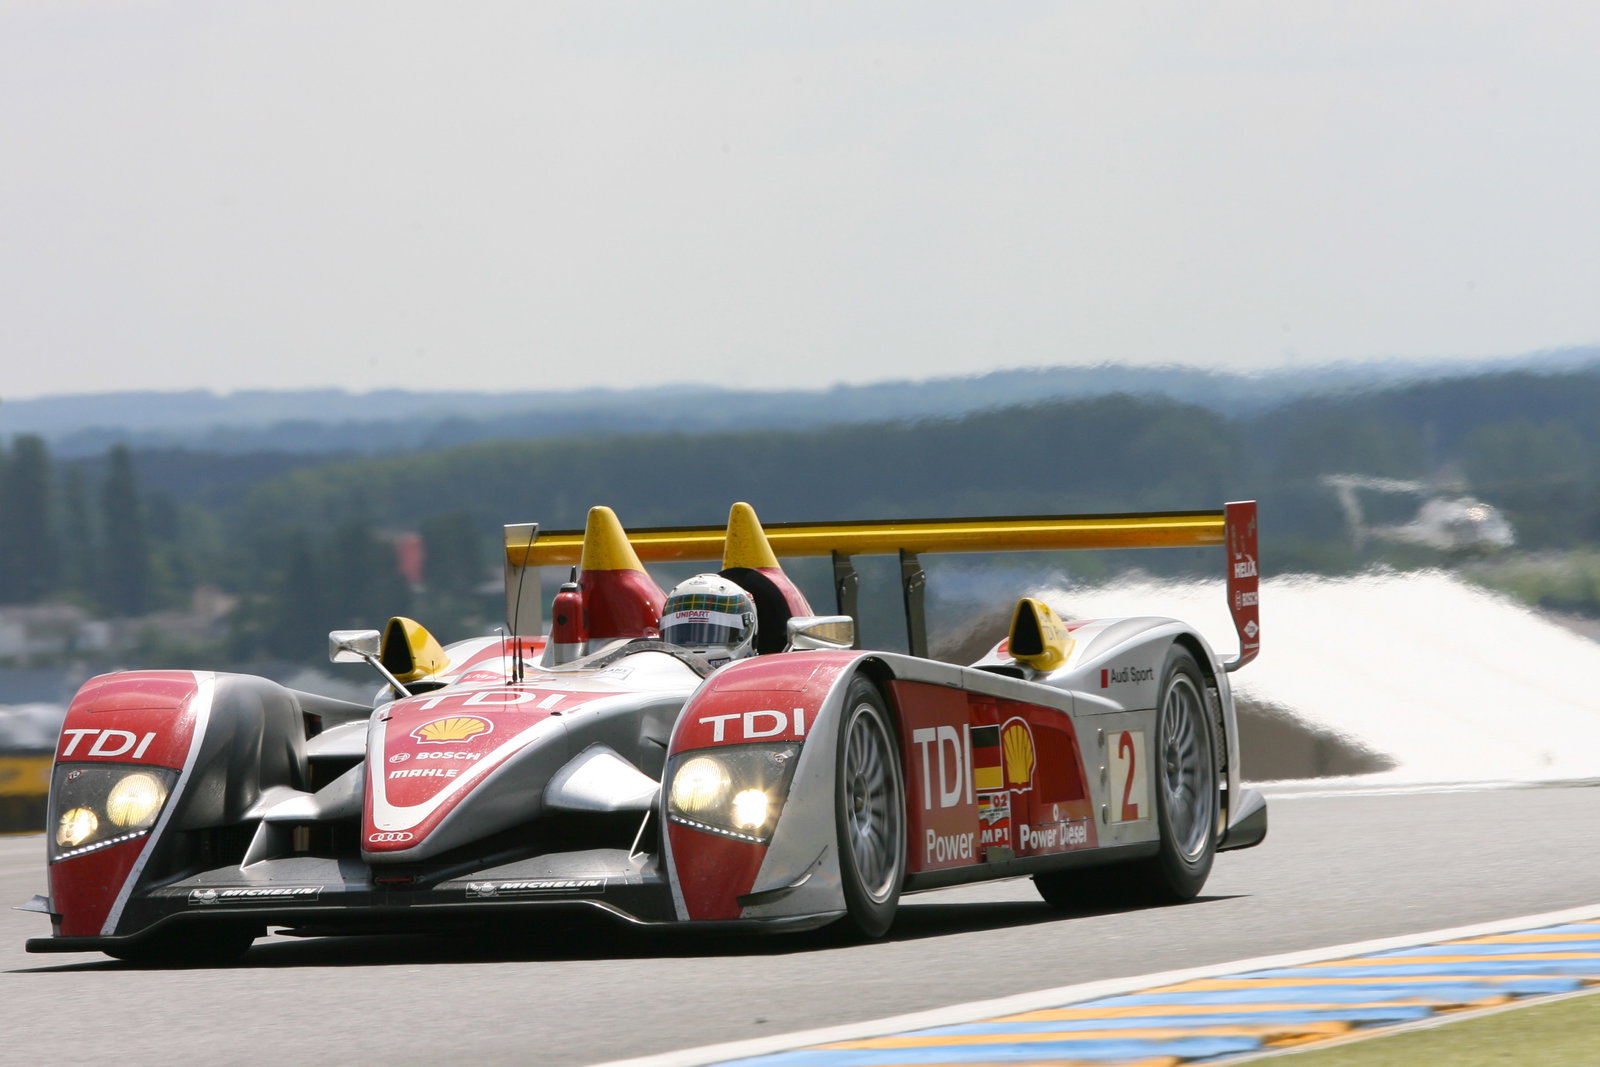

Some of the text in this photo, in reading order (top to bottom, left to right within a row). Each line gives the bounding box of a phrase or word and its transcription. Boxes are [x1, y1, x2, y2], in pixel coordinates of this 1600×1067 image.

[1234, 561, 1258, 579] HELIX
[675, 610, 711, 619] UNIPART
[1110, 667, 1154, 686] Audi Sport
[410, 691, 568, 711] TDI
[699, 708, 805, 742] TDI
[62, 728, 157, 759] TDI
[415, 751, 481, 761] BOSCH
[388, 768, 459, 780] MAHLE
[912, 723, 974, 810] TDI
[1118, 730, 1139, 822] 2
[993, 794, 1008, 808] 02
[980, 827, 1009, 844] MP1
[1019, 816, 1087, 850] Power Diesel
[926, 829, 974, 864] Power
[220, 887, 319, 897] MICHELIN
[500, 880, 601, 889] MICHELIN
